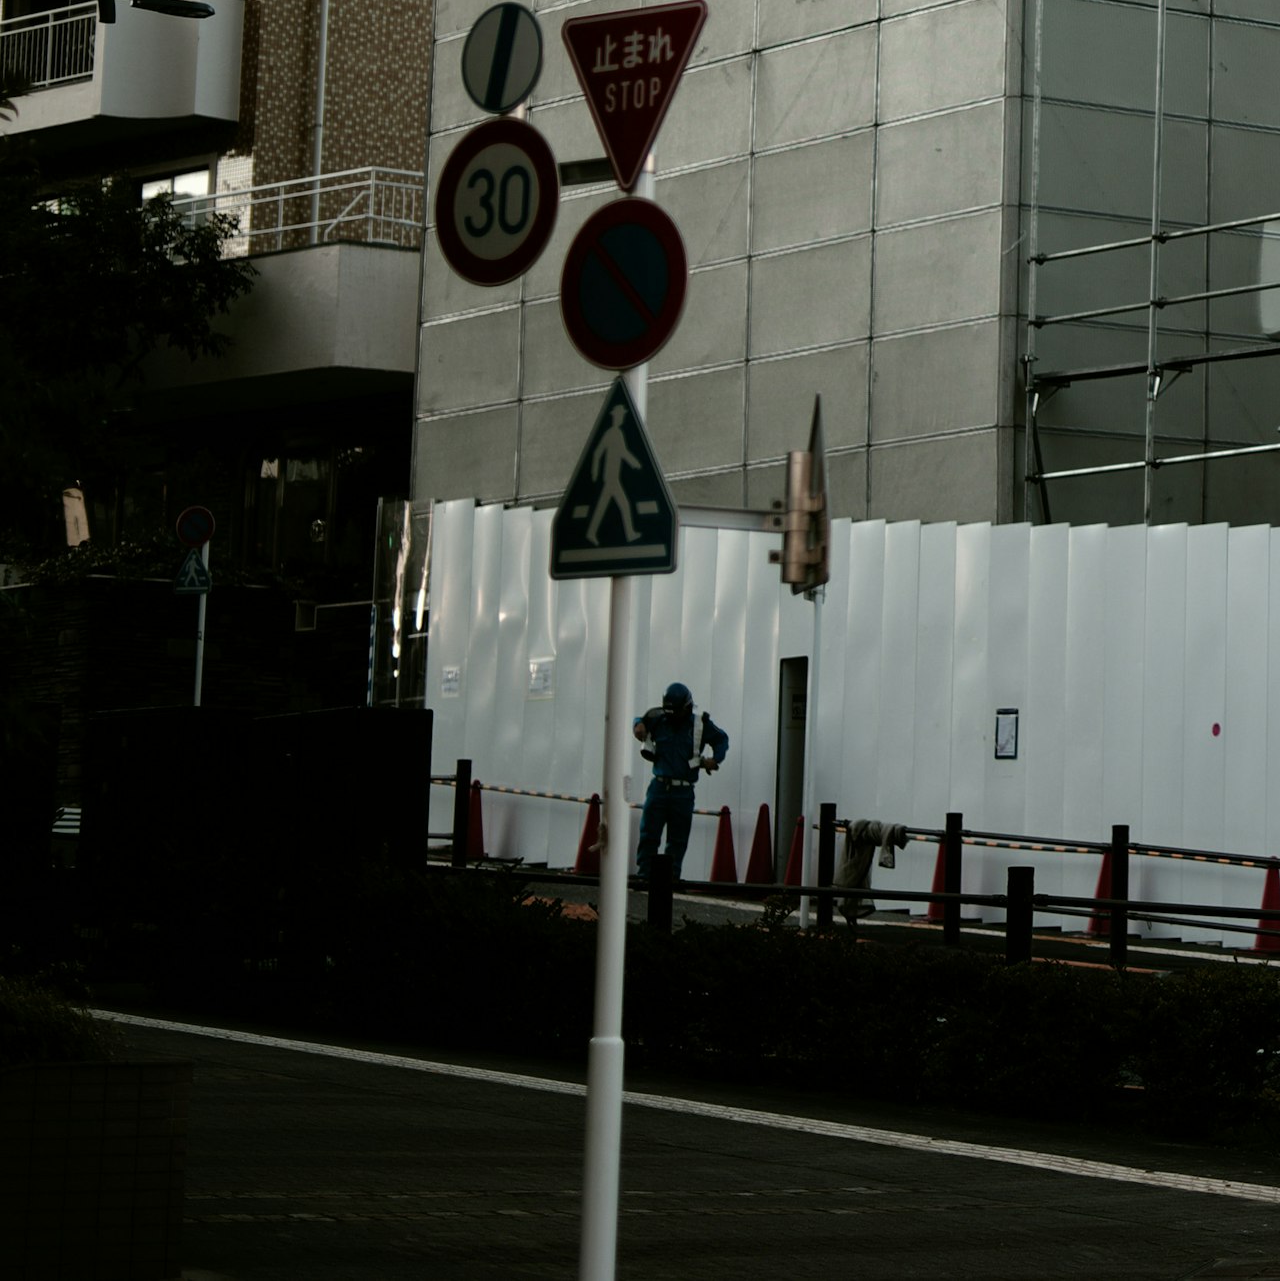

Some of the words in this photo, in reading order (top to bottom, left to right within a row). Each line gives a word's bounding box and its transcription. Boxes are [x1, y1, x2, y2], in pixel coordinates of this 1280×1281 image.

[592, 26, 675, 73] 止まれ
[605, 77, 662, 113] STOP
[464, 165, 529, 237] 30
